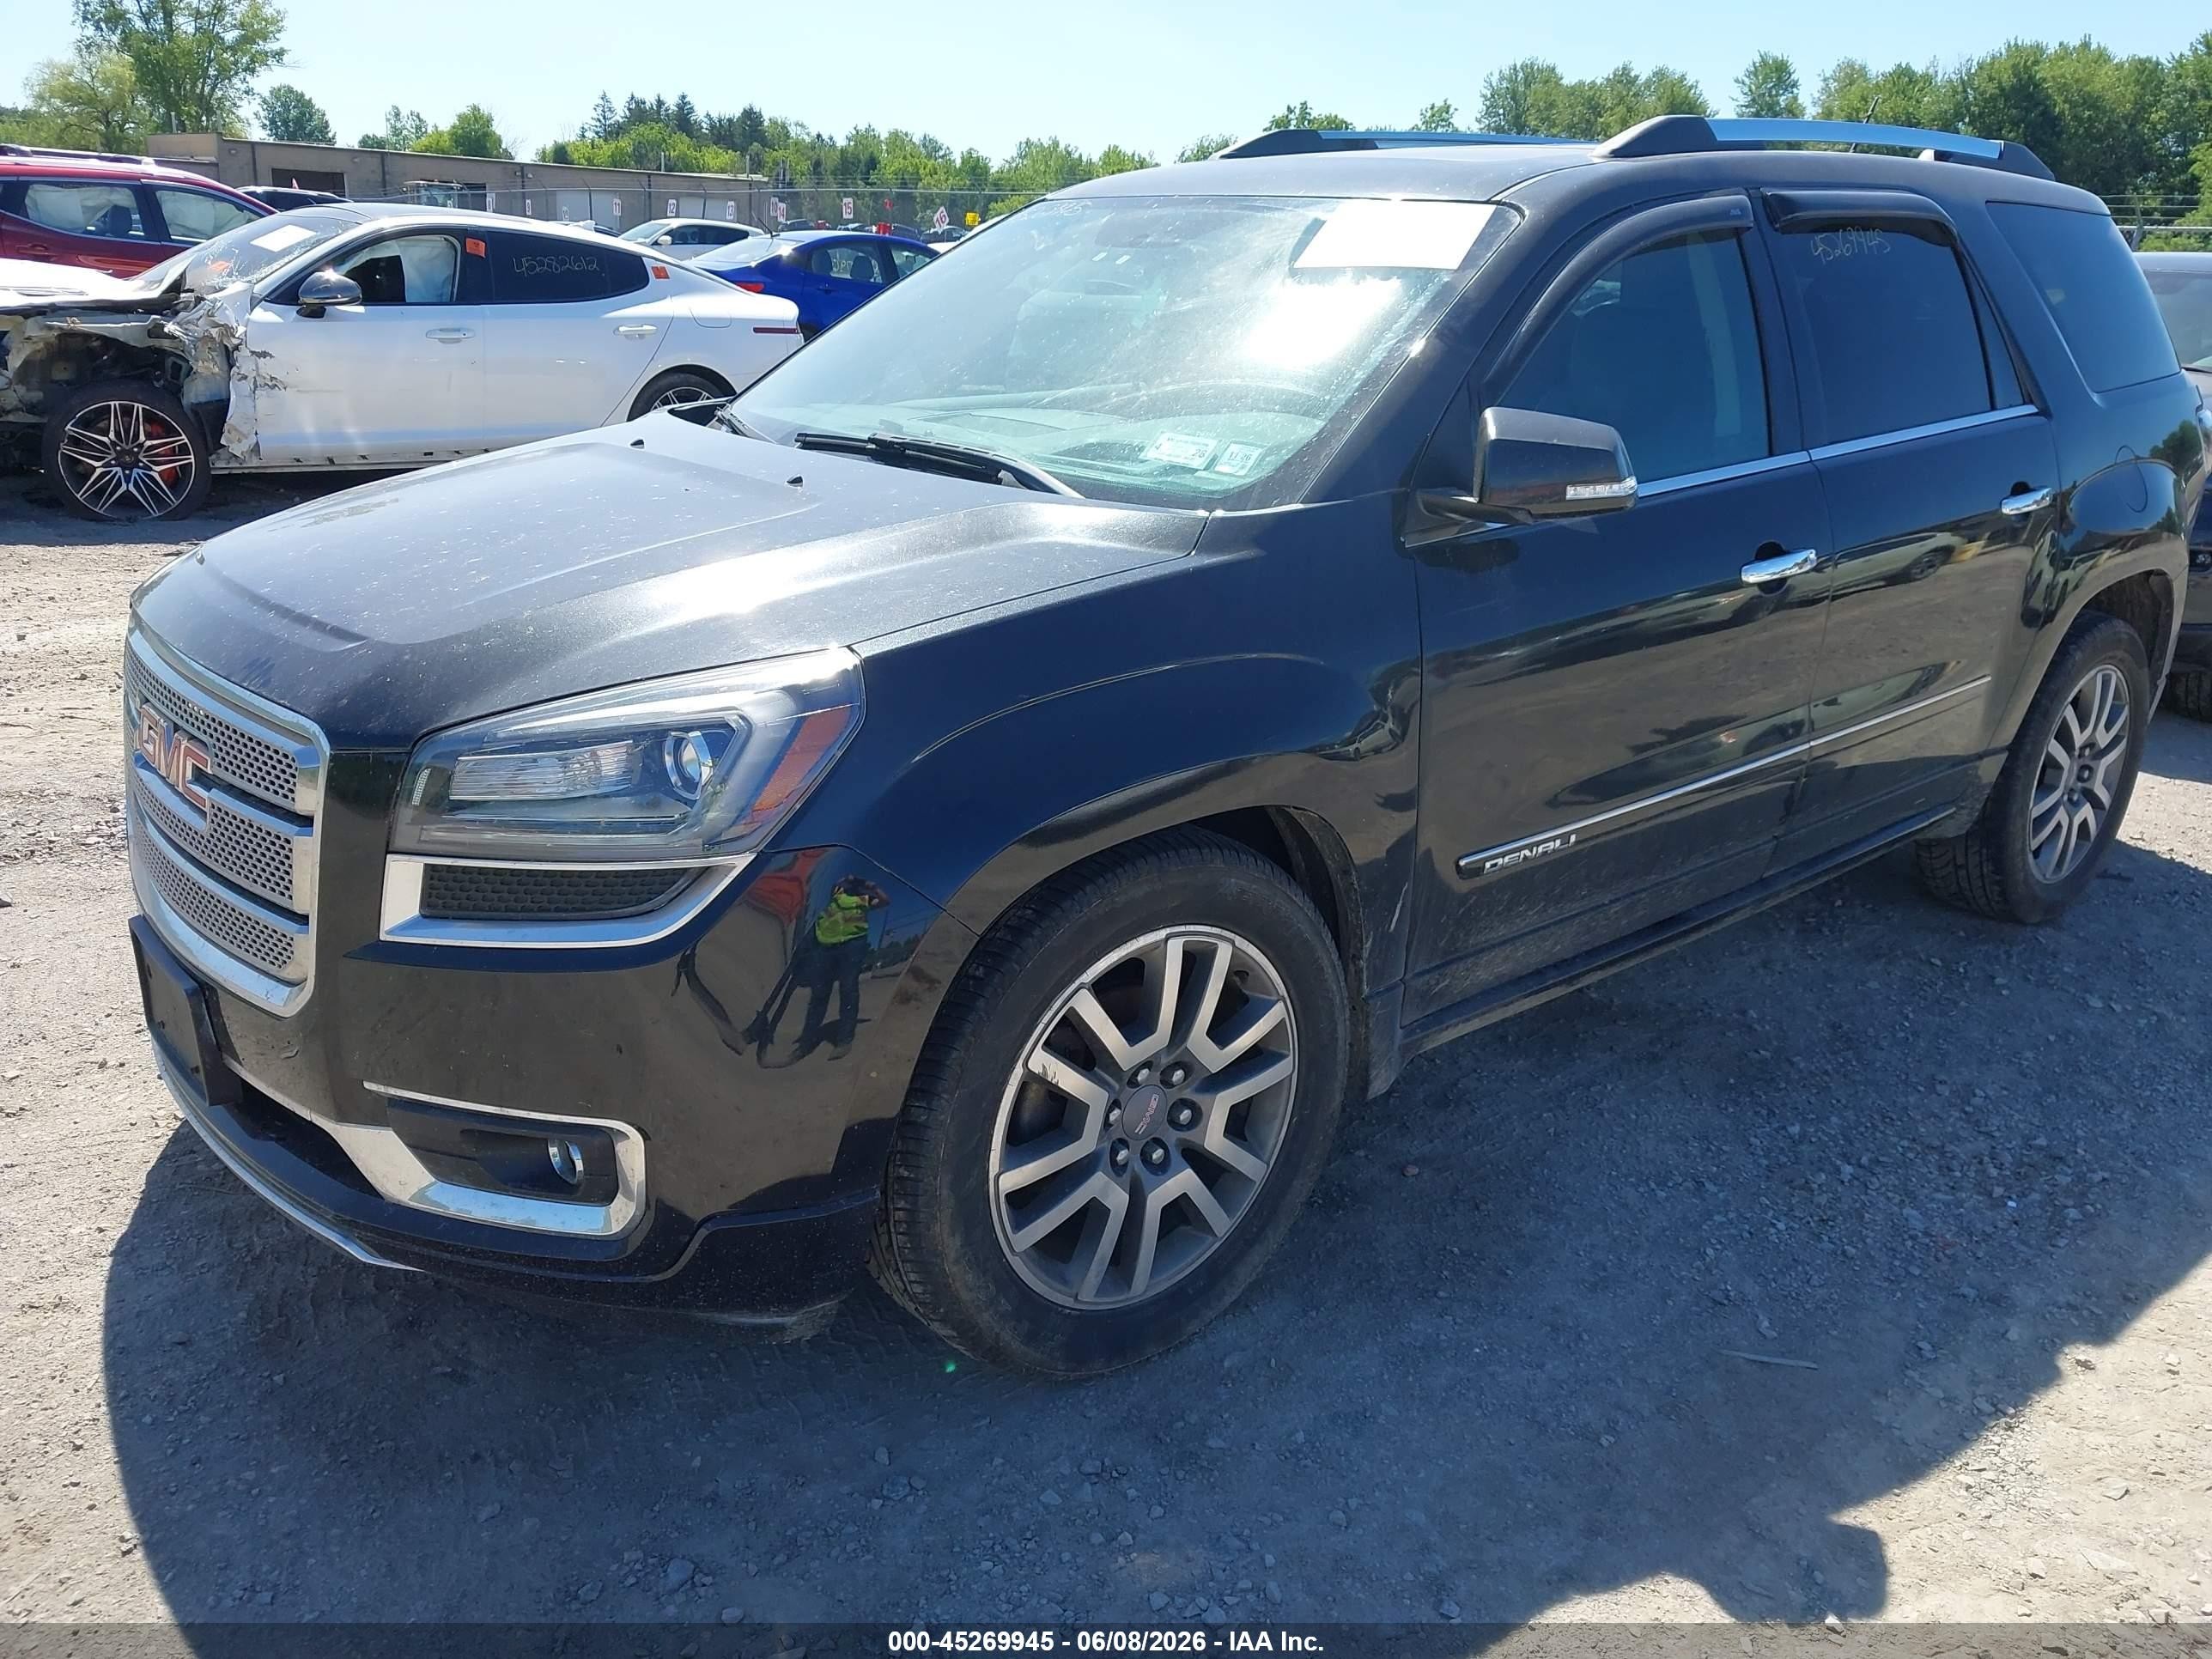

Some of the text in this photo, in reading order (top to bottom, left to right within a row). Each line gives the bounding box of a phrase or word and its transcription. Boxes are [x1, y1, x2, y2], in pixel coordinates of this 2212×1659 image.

[613, 201, 621, 214] 11
[668, 202, 676, 214] 12
[727, 204, 734, 216] 13
[778, 205, 785, 220] 14
[843, 201, 852, 216] 15
[935, 211, 947, 228] 16
[1810, 226, 1891, 265] 45269945
[513, 255, 600, 276] 45282612
[138, 702, 213, 813] GMC
[1483, 833, 1577, 874] DENALI
[1134, 1093, 1159, 1135] GMC
